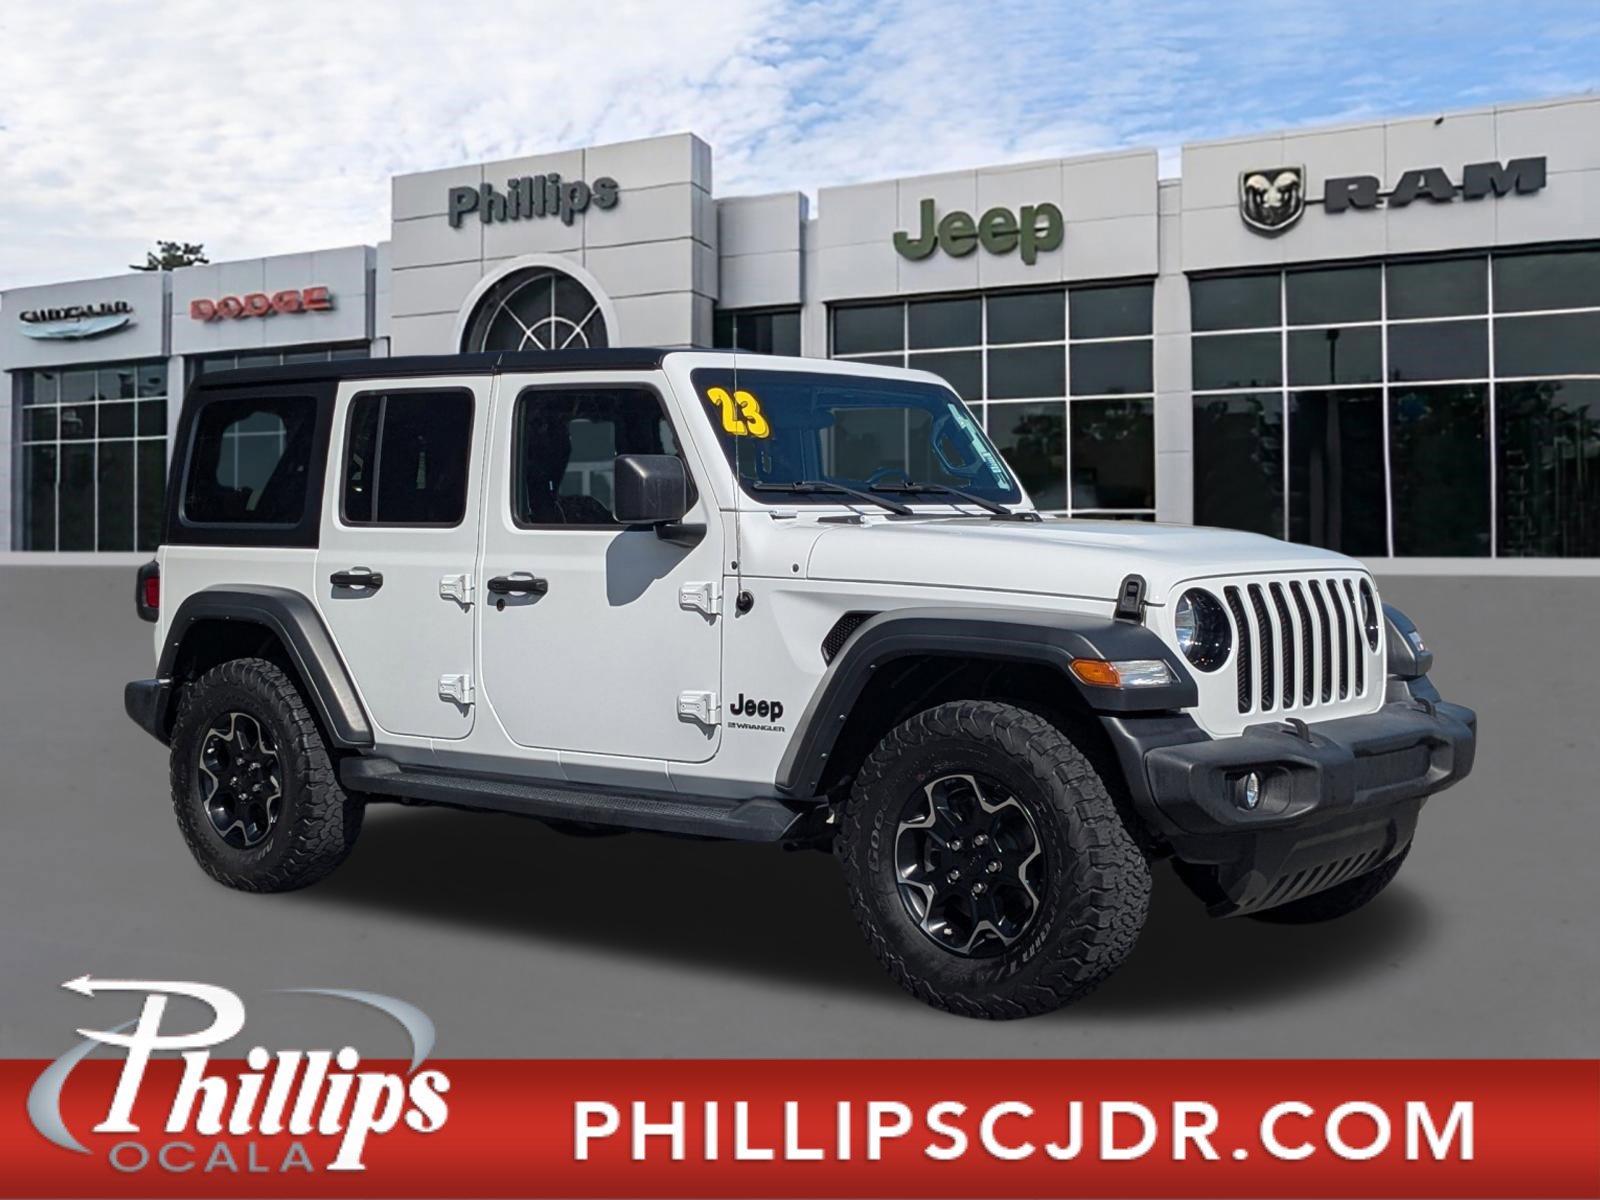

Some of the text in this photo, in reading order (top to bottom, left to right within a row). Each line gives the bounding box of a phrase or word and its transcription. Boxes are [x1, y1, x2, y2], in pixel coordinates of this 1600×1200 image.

[448, 173, 619, 228] Phillips
[1324, 156, 1548, 214] RAM
[893, 198, 1065, 266] Jeep
[190, 286, 332, 322] DODGE
[706, 386, 770, 438] 23
[730, 693, 783, 722] Jeep
[736, 722, 785, 732] WRANGLER
